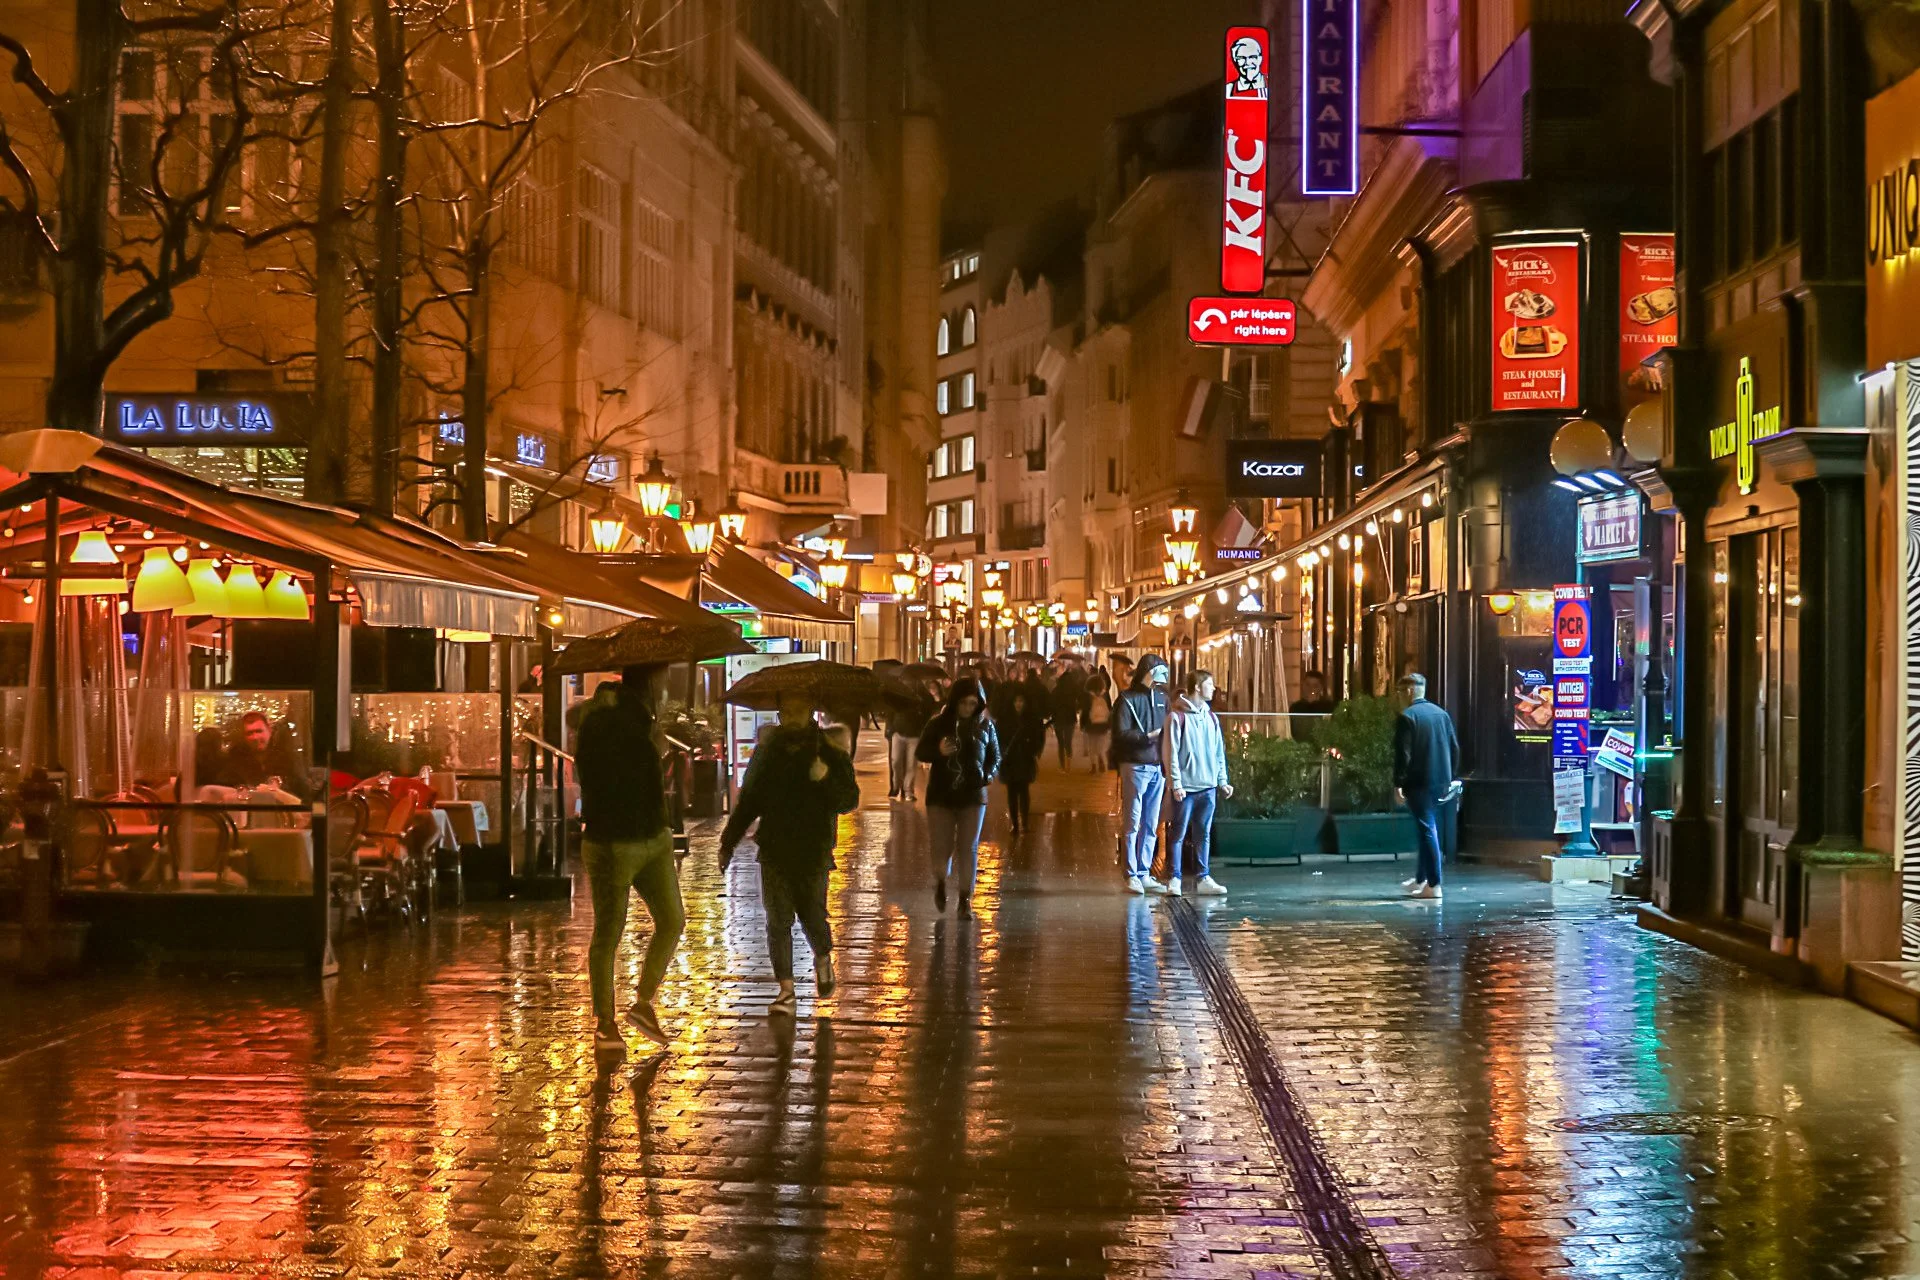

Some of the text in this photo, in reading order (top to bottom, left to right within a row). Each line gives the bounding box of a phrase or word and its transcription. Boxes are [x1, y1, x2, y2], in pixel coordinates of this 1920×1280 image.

[1225, 134, 1265, 257] KFC
[1512, 260, 1549, 271] RICK's
[1230, 308, 1292, 321] pár lépésre
[1234, 325, 1287, 337] right here
[1622, 334, 1654, 343] STEAK
[1503, 369, 1561, 380] STEAK HOUSE
[1521, 379, 1535, 388] and
[1503, 390, 1560, 401] RESTAURANT
[121, 402, 164, 431] LA
[1242, 461, 1304, 476] Kazar
[1594, 521, 1626, 546] MARKET
[1217, 550, 1261, 559] HUMANIC
[1555, 587, 1574, 599] COVID
[1559, 617, 1584, 635] PCR
[1562, 638, 1581, 648] TEST
[1558, 682, 1584, 694] ANTIGEN
[1555, 709, 1588, 718] COVID TEST
[1606, 738, 1630, 755] COVID
